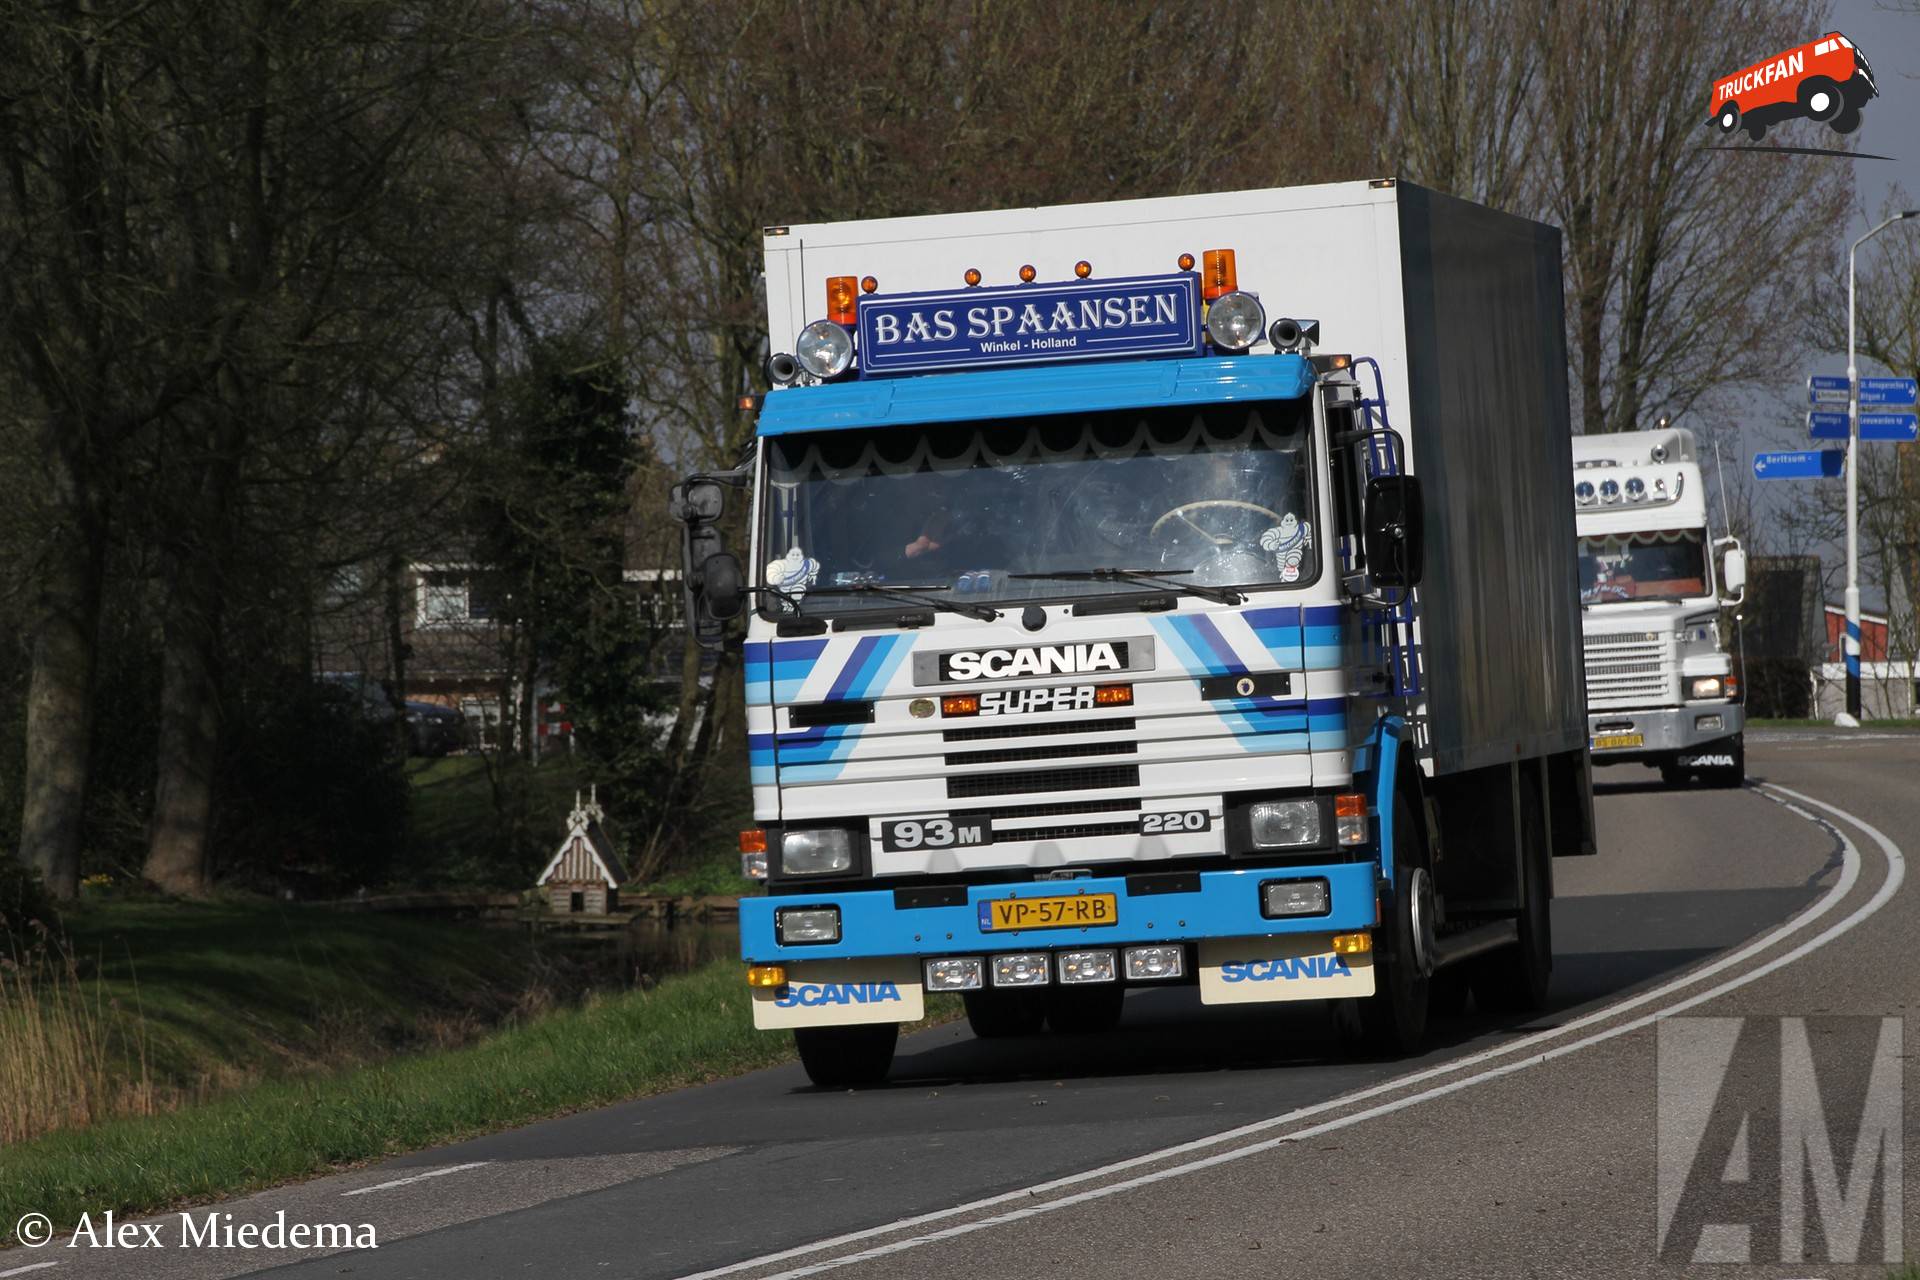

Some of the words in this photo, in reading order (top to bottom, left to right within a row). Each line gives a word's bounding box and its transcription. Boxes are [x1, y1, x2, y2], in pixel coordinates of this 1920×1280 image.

[875, 310, 958, 345] BAS
[967, 292, 1179, 338] SPAANSEN
[980, 340, 1021, 353] Winkel
[1031, 336, 1077, 349] Holland
[948, 642, 1121, 681] SCANIA
[979, 685, 1096, 716] SUPER
[1678, 755, 1734, 766] SCANIA
[1143, 811, 1205, 833] 220
[981, 918, 991, 926] NL
[999, 899, 1106, 924] VP-57-RB
[1221, 955, 1353, 983] SCANIA
[774, 981, 902, 1008] SCANIA
